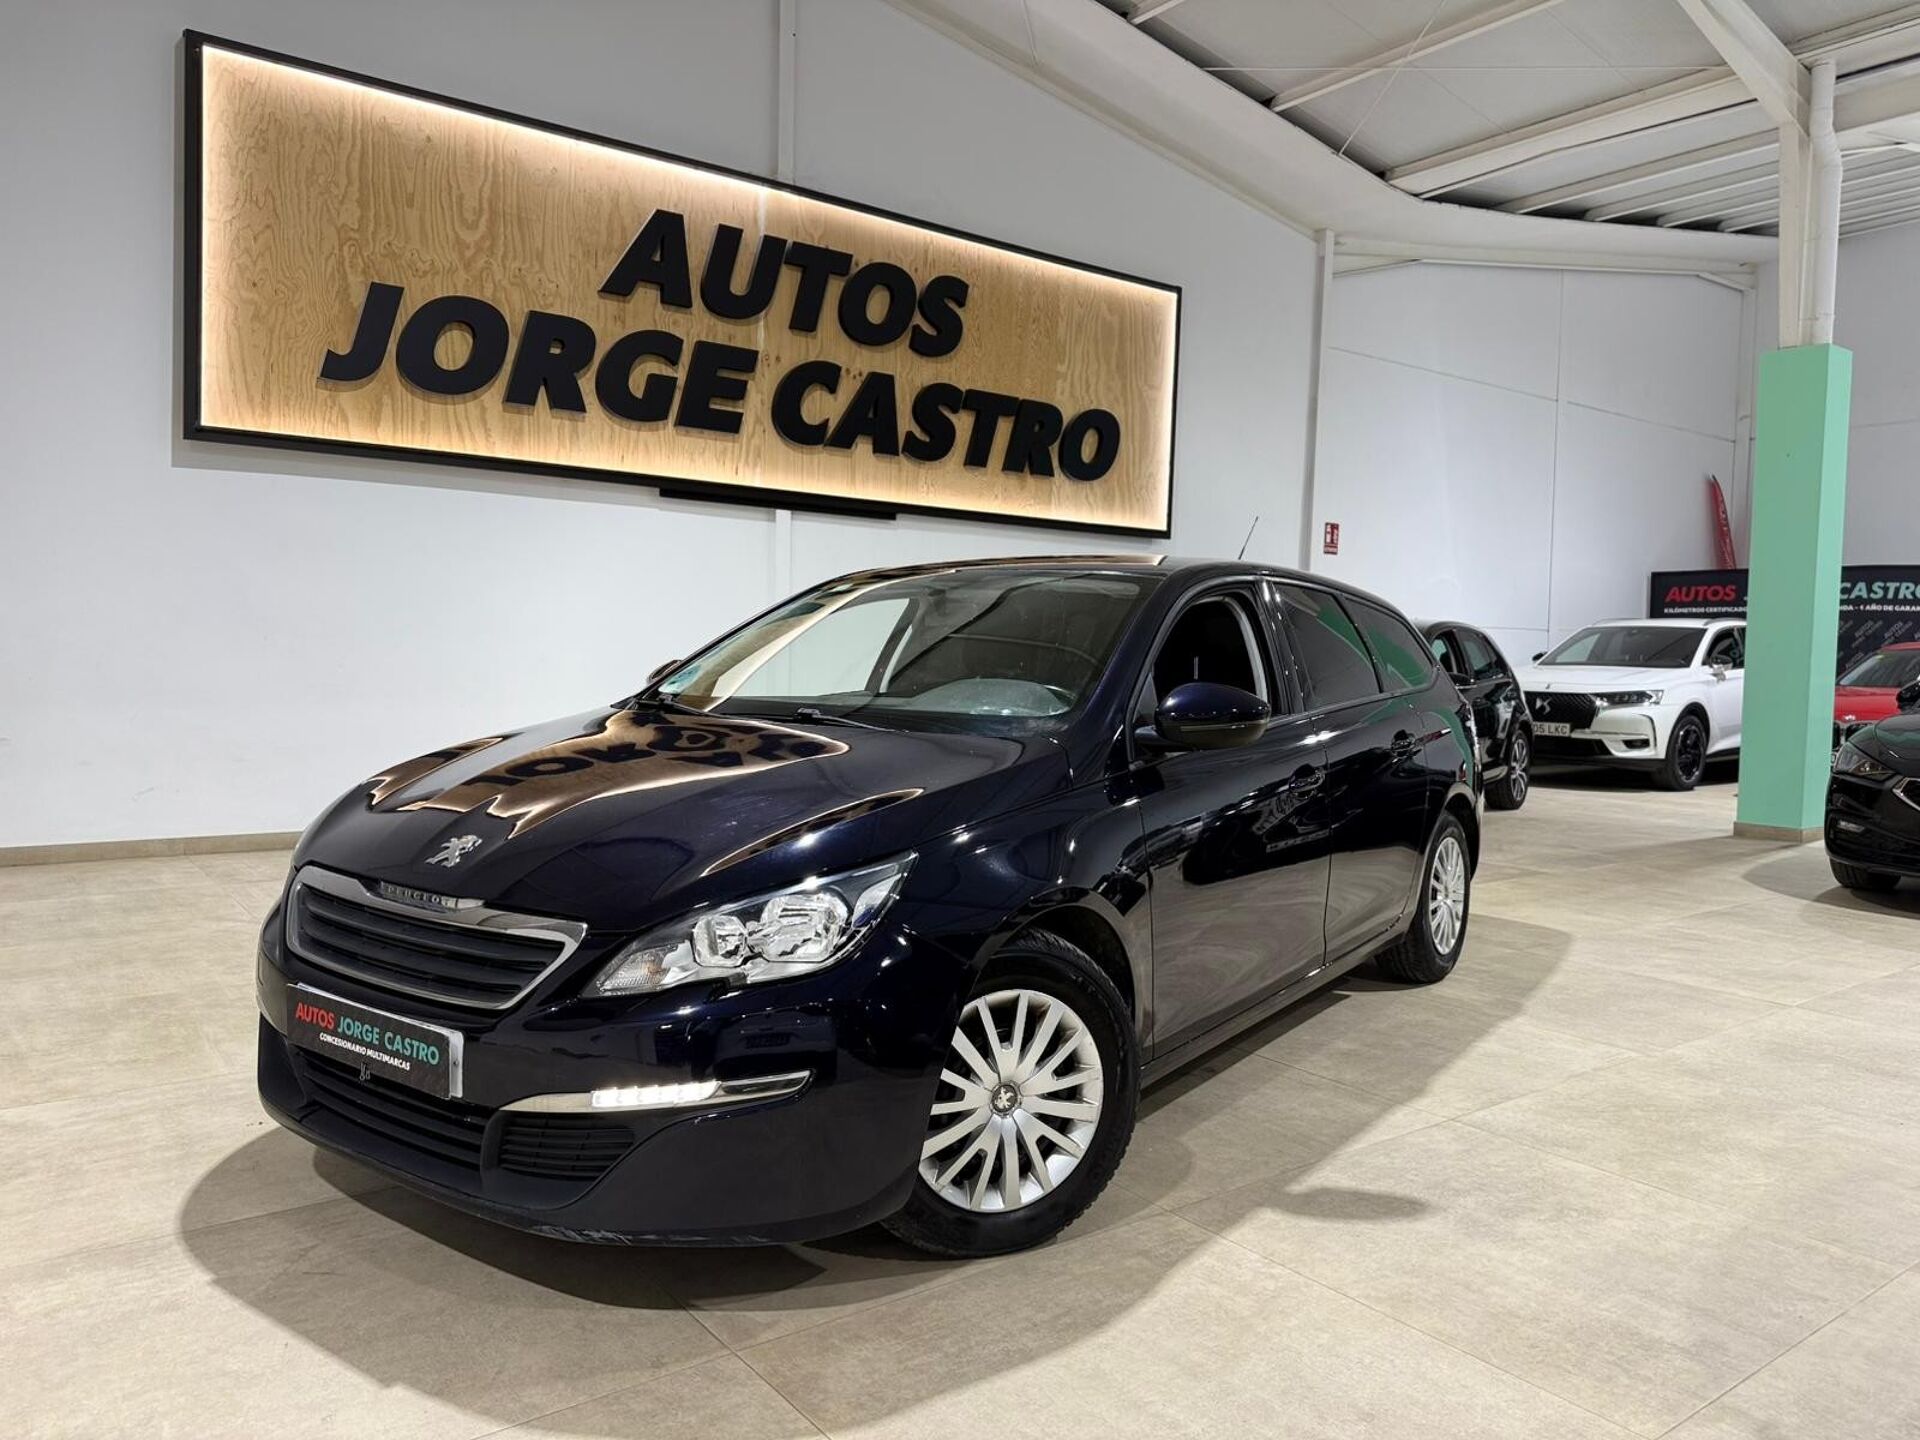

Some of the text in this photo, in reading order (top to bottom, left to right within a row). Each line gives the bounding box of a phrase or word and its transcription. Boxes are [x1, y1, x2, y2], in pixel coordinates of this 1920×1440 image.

[600, 209, 969, 358] AUTOS
[320, 282, 1121, 482] JORGE CASTRO
[1665, 585, 1737, 602] AUTOS
[295, 1002, 440, 1065] AUTOS JORGE CASTRO
[319, 1031, 411, 1071] CONCESIONARIO MULTIMARCAS
